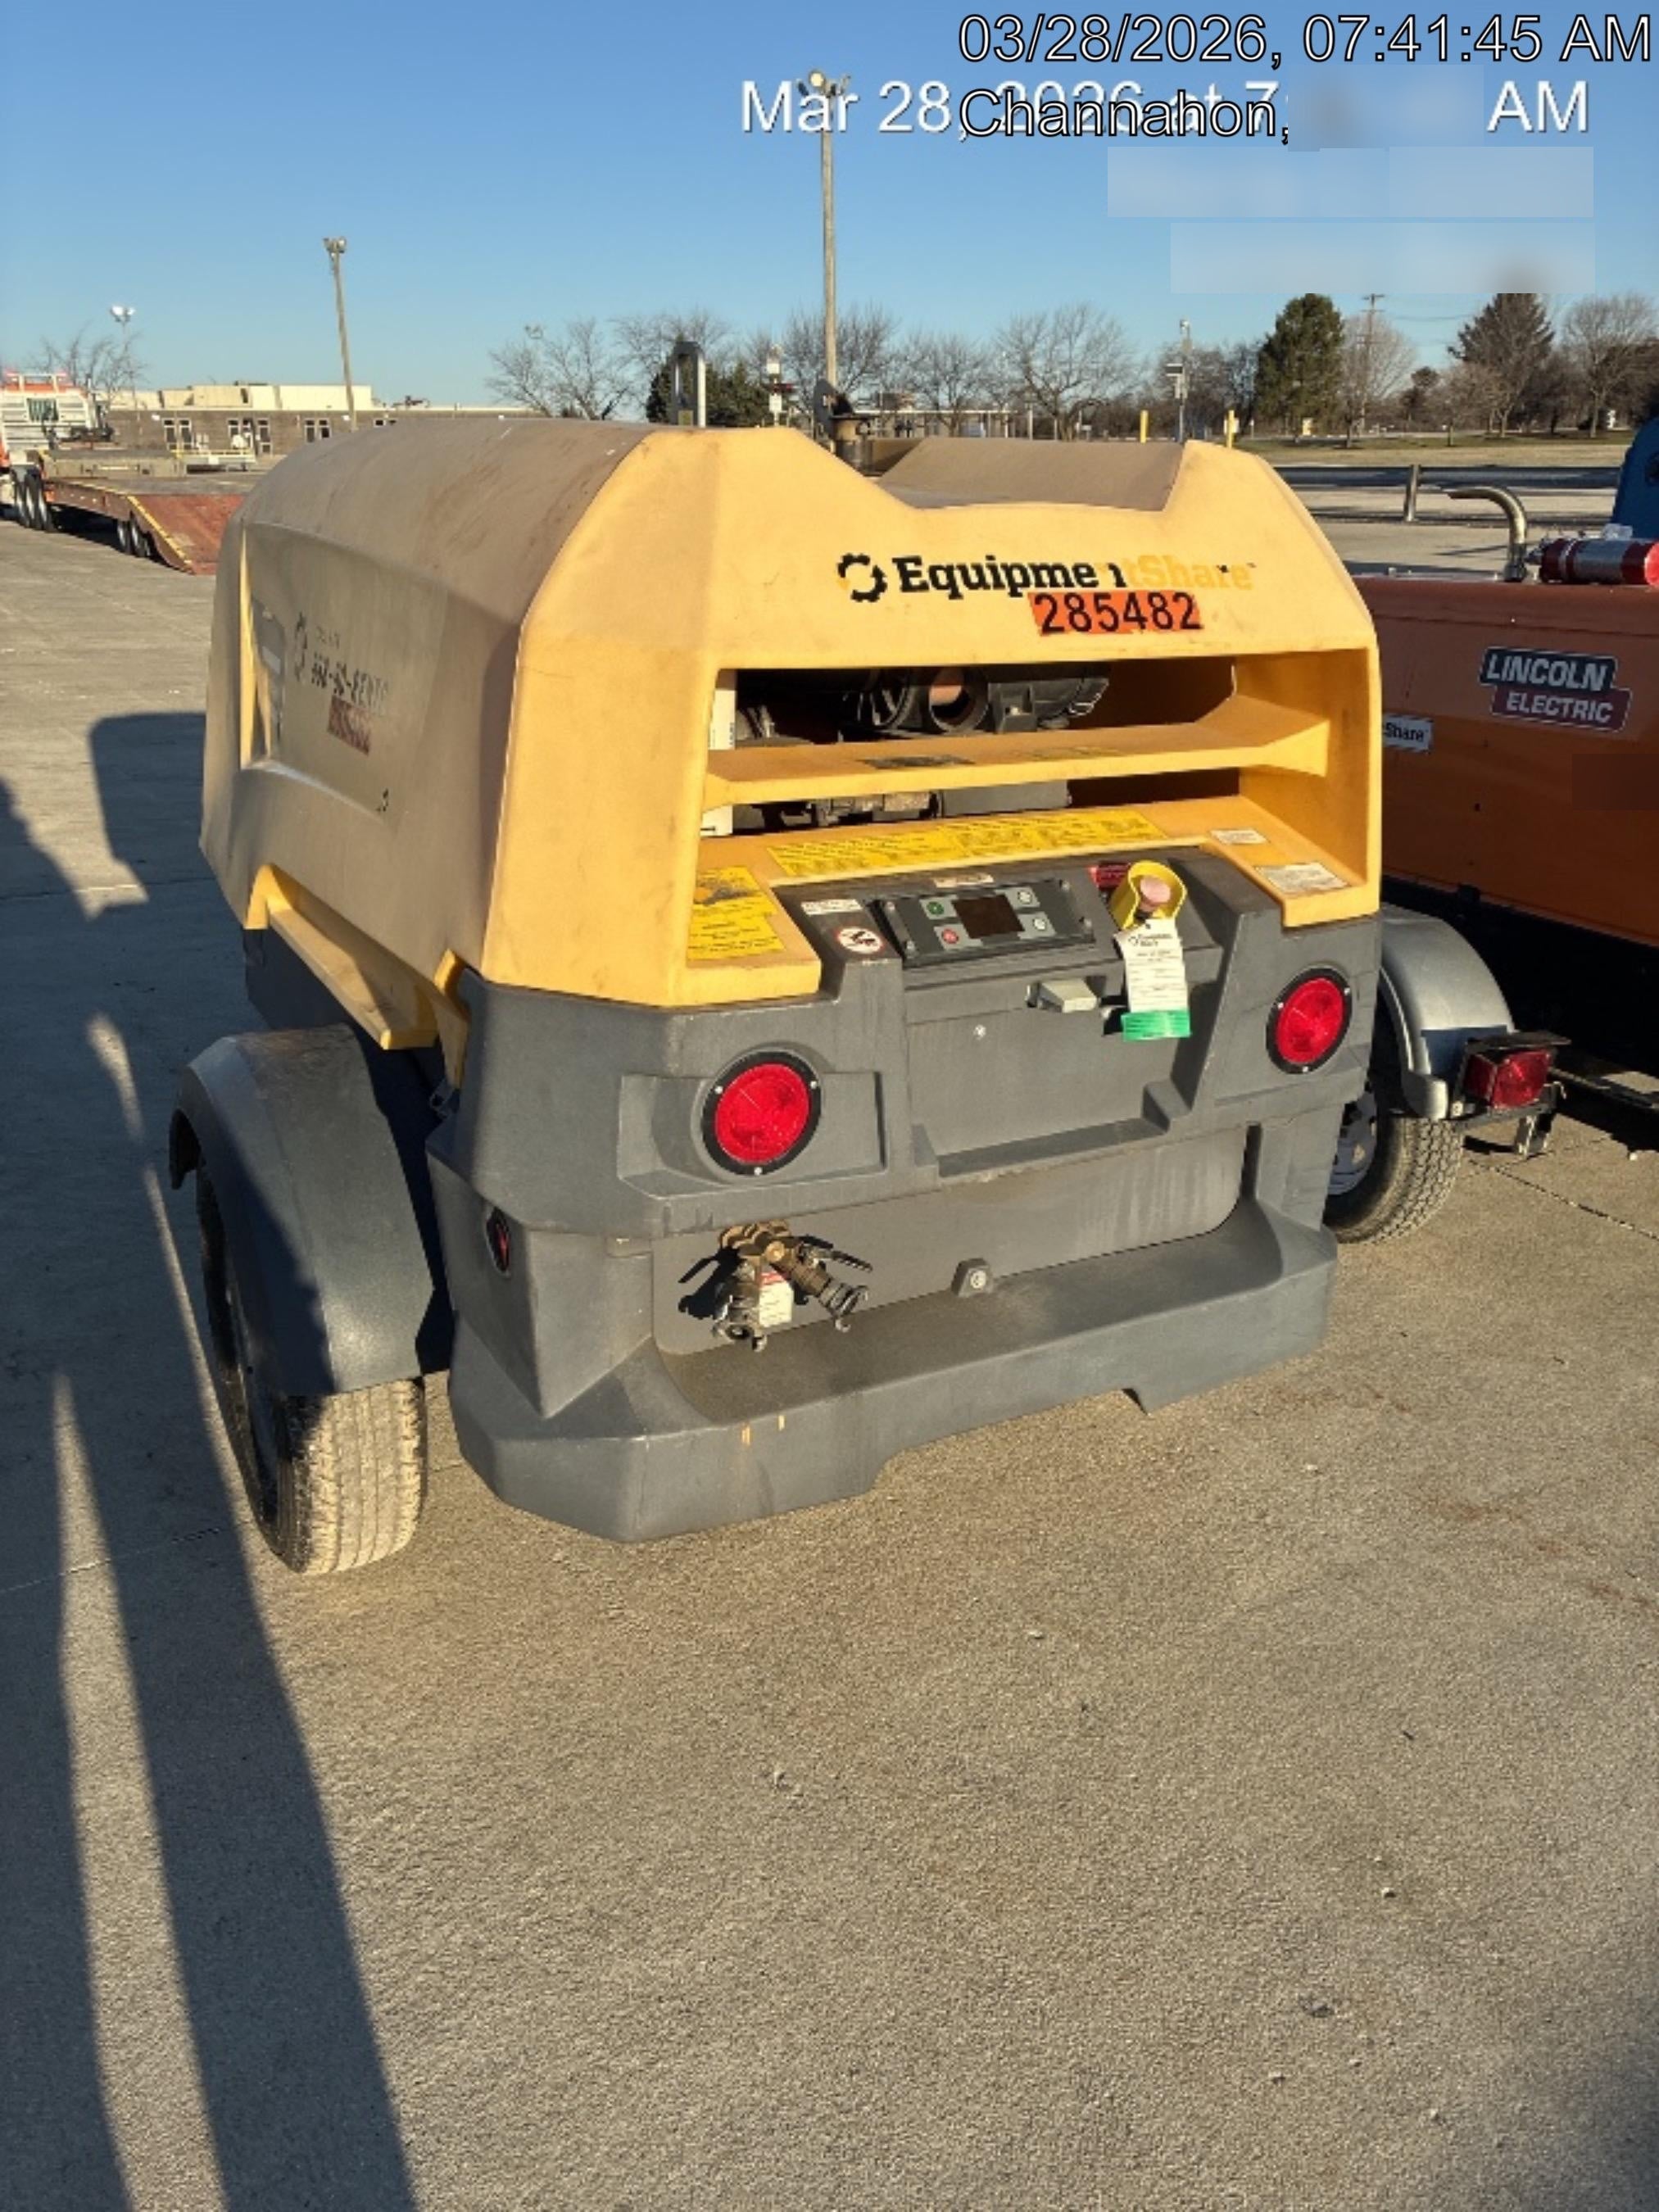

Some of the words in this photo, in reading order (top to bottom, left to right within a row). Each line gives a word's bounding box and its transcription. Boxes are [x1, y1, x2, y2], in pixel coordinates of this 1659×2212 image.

[1034, 592, 1202, 634] 285482
[1486, 654, 1609, 692] LINCOLN
[1506, 691, 1613, 724] ELECTRIC
[1383, 721, 1426, 743] Share
